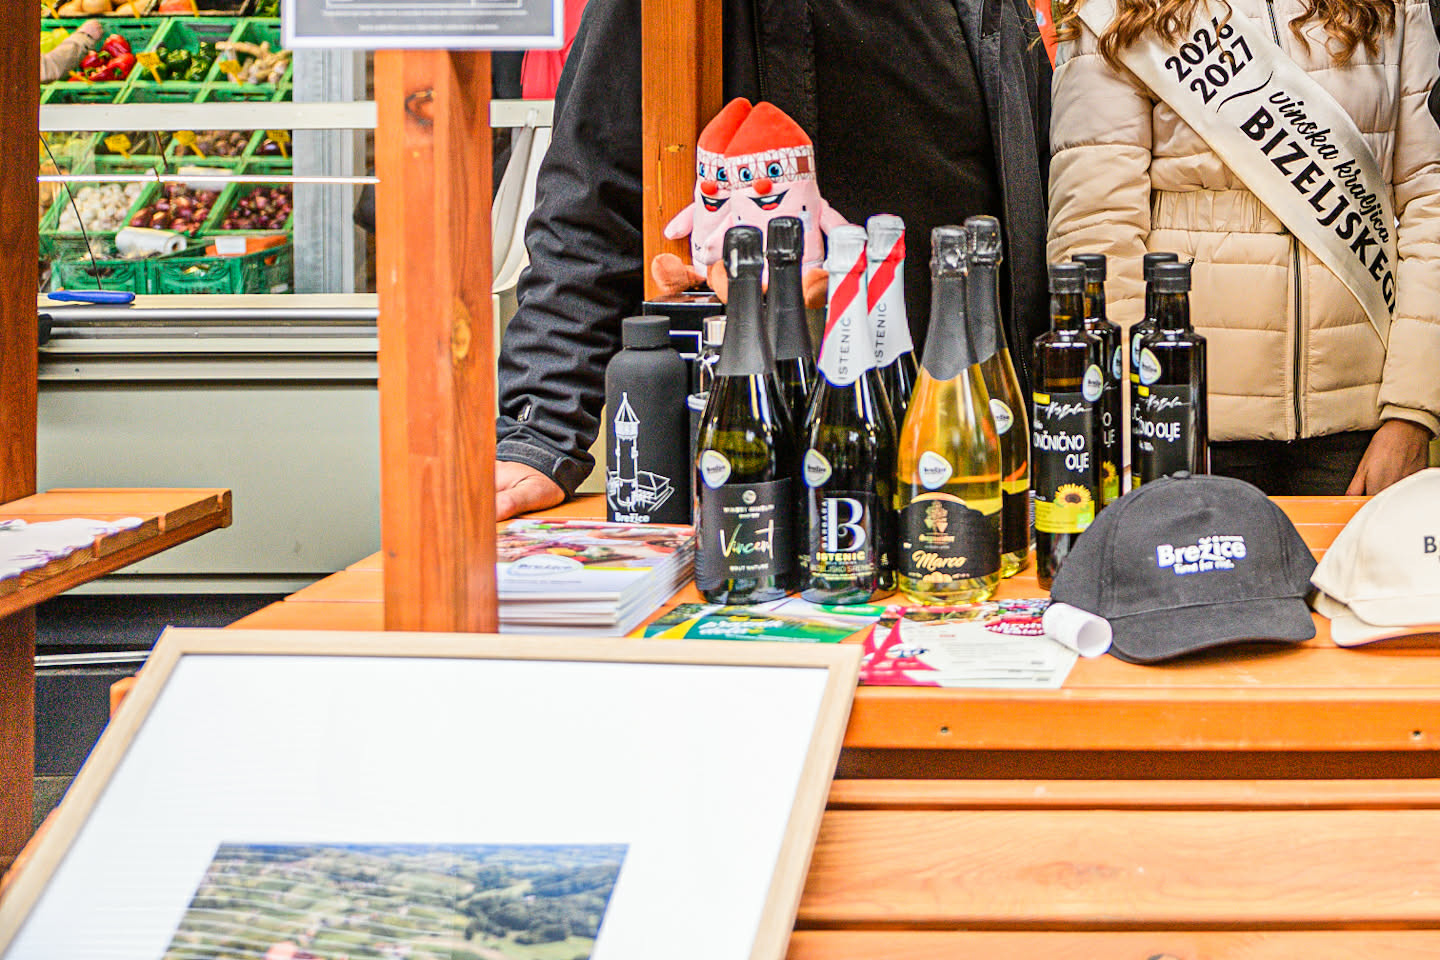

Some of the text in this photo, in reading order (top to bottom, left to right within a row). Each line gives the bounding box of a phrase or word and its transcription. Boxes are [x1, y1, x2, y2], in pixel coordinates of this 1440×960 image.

[1164, 16, 1235, 84] 2026
[1190, 35, 1255, 105] 2027
[1268, 90, 1390, 244] vinska kraljica
[1033, 430, 1086, 452] ONČNIČNO
[1155, 421, 1181, 442] OLJE
[1065, 452, 1090, 473] OLJE
[719, 518, 775, 560] Vincent
[822, 497, 867, 553] B
[911, 550, 968, 572] Marco
[1156, 535, 1248, 568] Brežice
